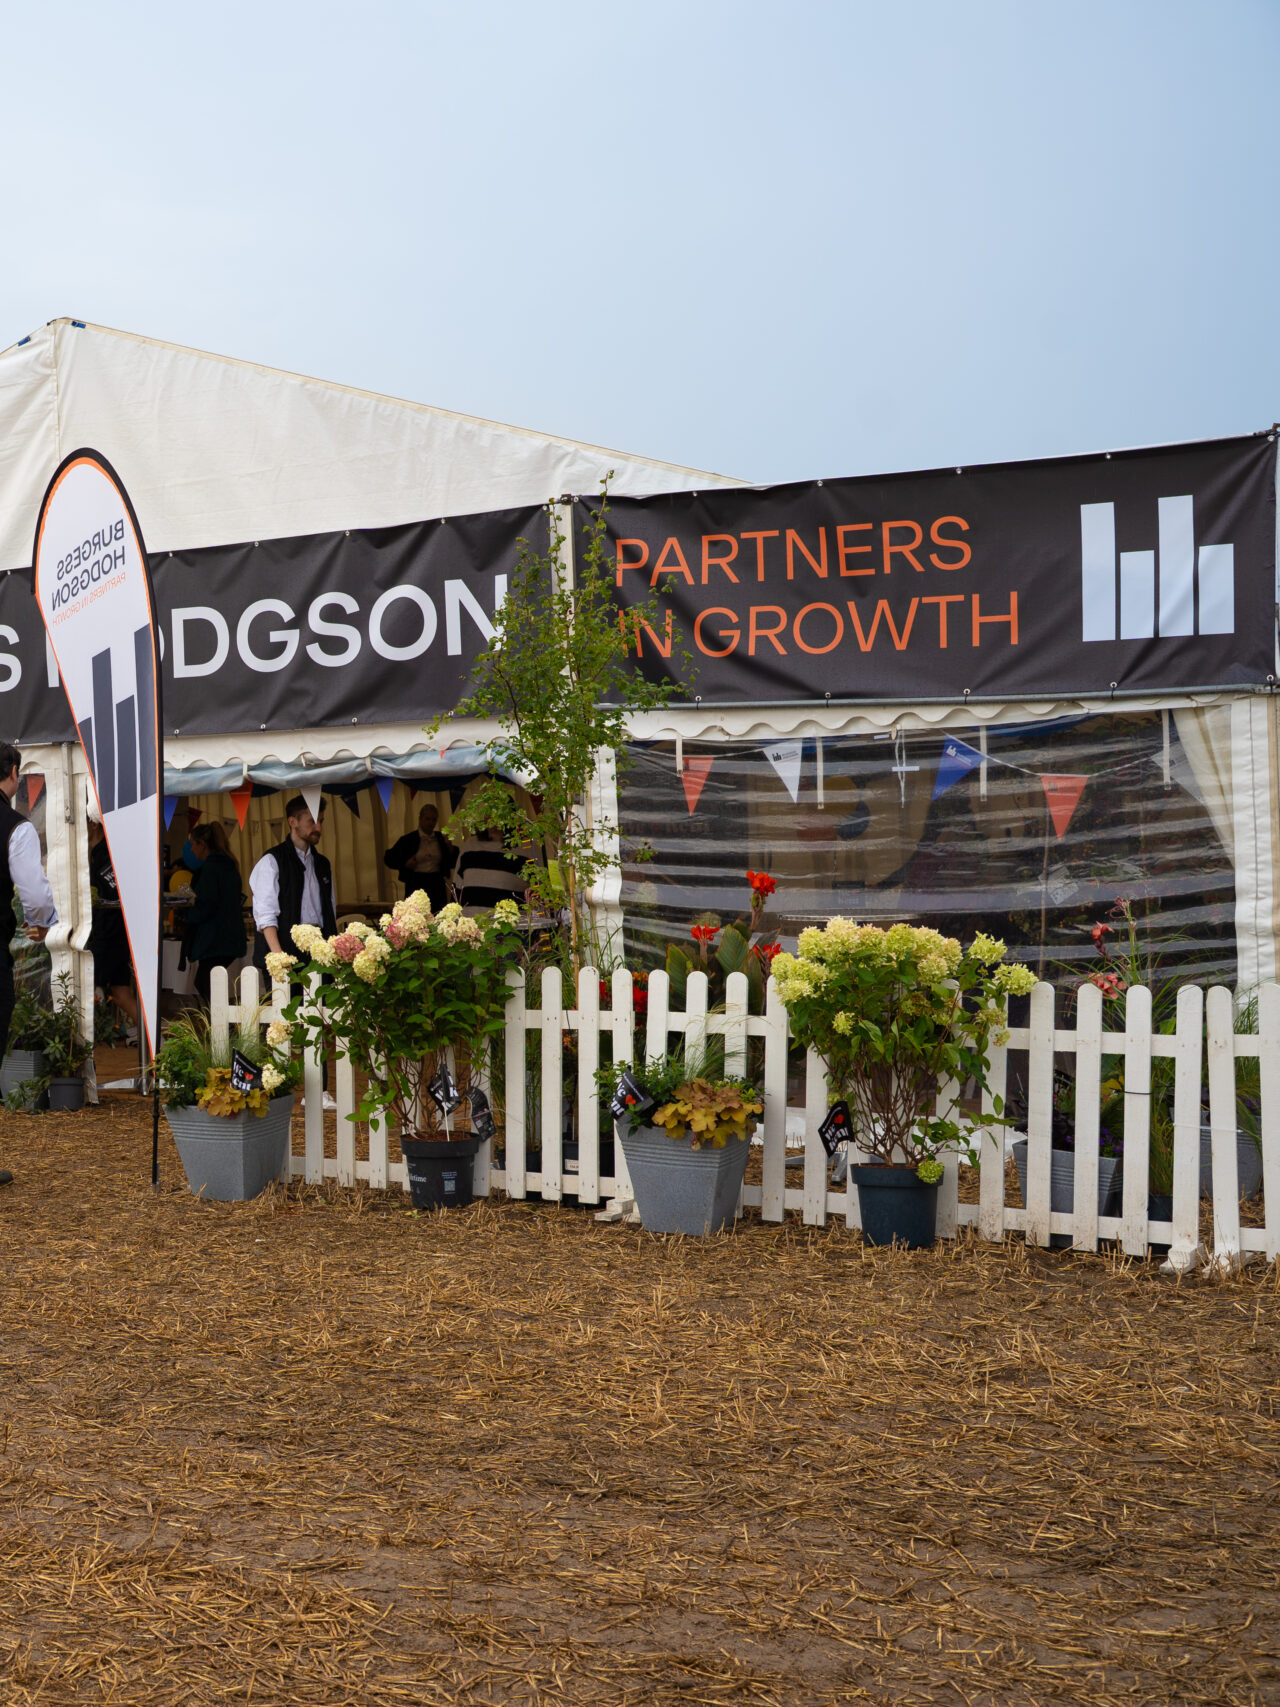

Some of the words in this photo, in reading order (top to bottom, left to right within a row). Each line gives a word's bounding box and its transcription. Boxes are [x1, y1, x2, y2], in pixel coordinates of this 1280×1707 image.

[615, 515, 972, 587] PARTNERS
[46, 574, 508, 688] DGSON
[618, 609, 673, 658] IN
[693, 590, 1019, 659] GROWTH
